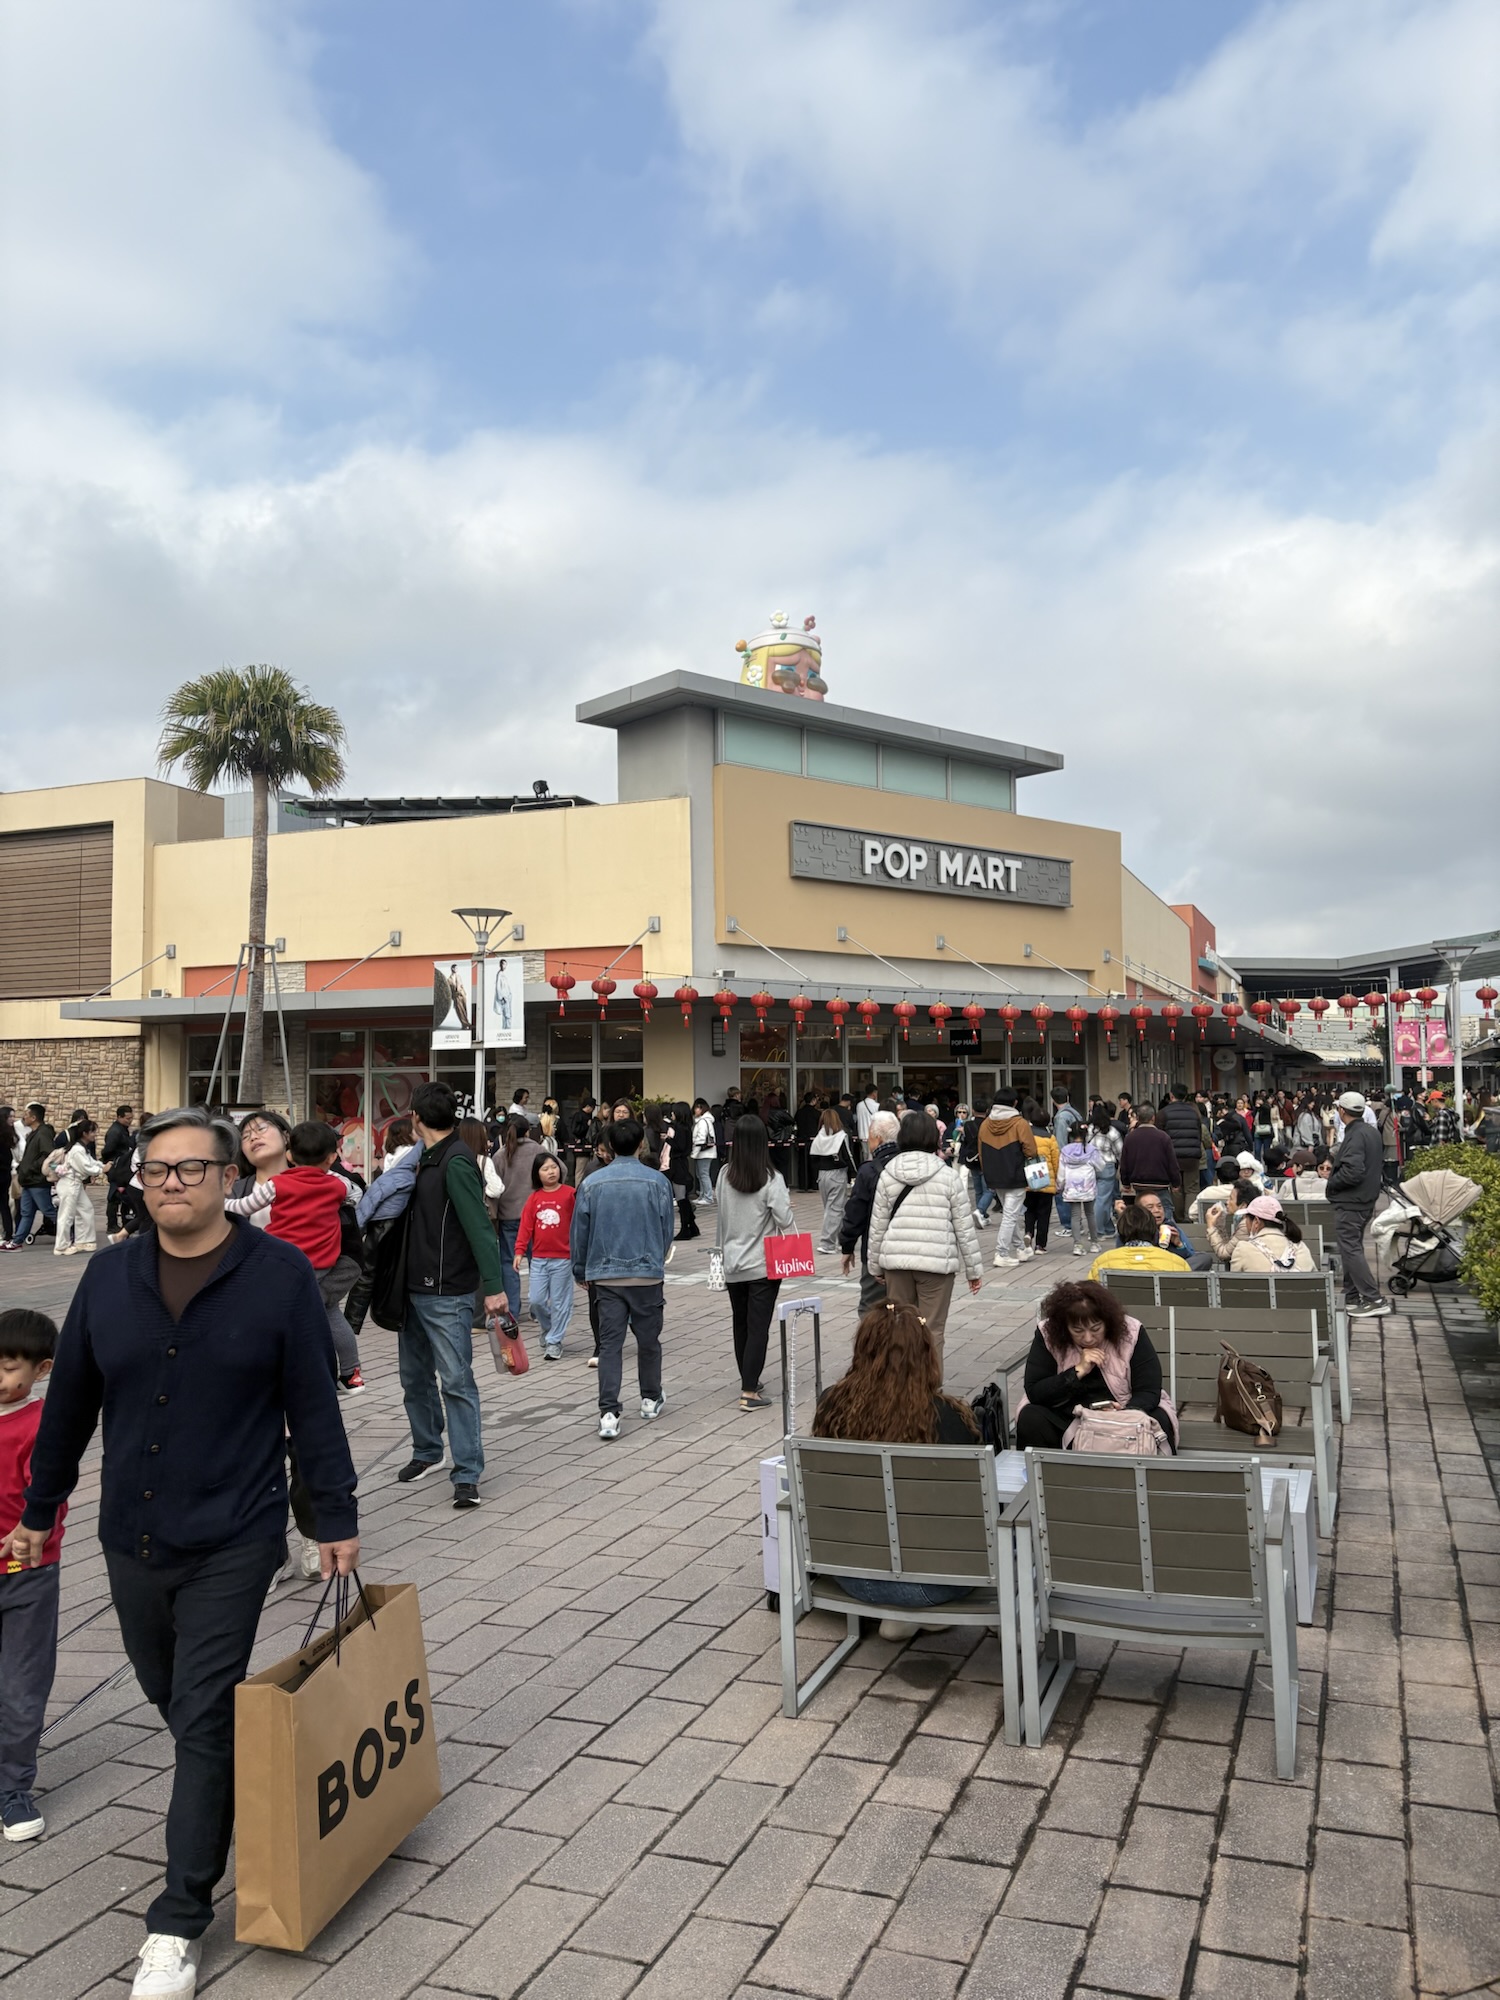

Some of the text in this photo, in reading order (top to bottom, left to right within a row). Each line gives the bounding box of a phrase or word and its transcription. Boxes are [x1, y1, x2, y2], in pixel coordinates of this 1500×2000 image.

[863, 839, 1023, 892] POP MART
[951, 1039, 963, 1047] POP
[318, 1679, 424, 1840] BOSS
